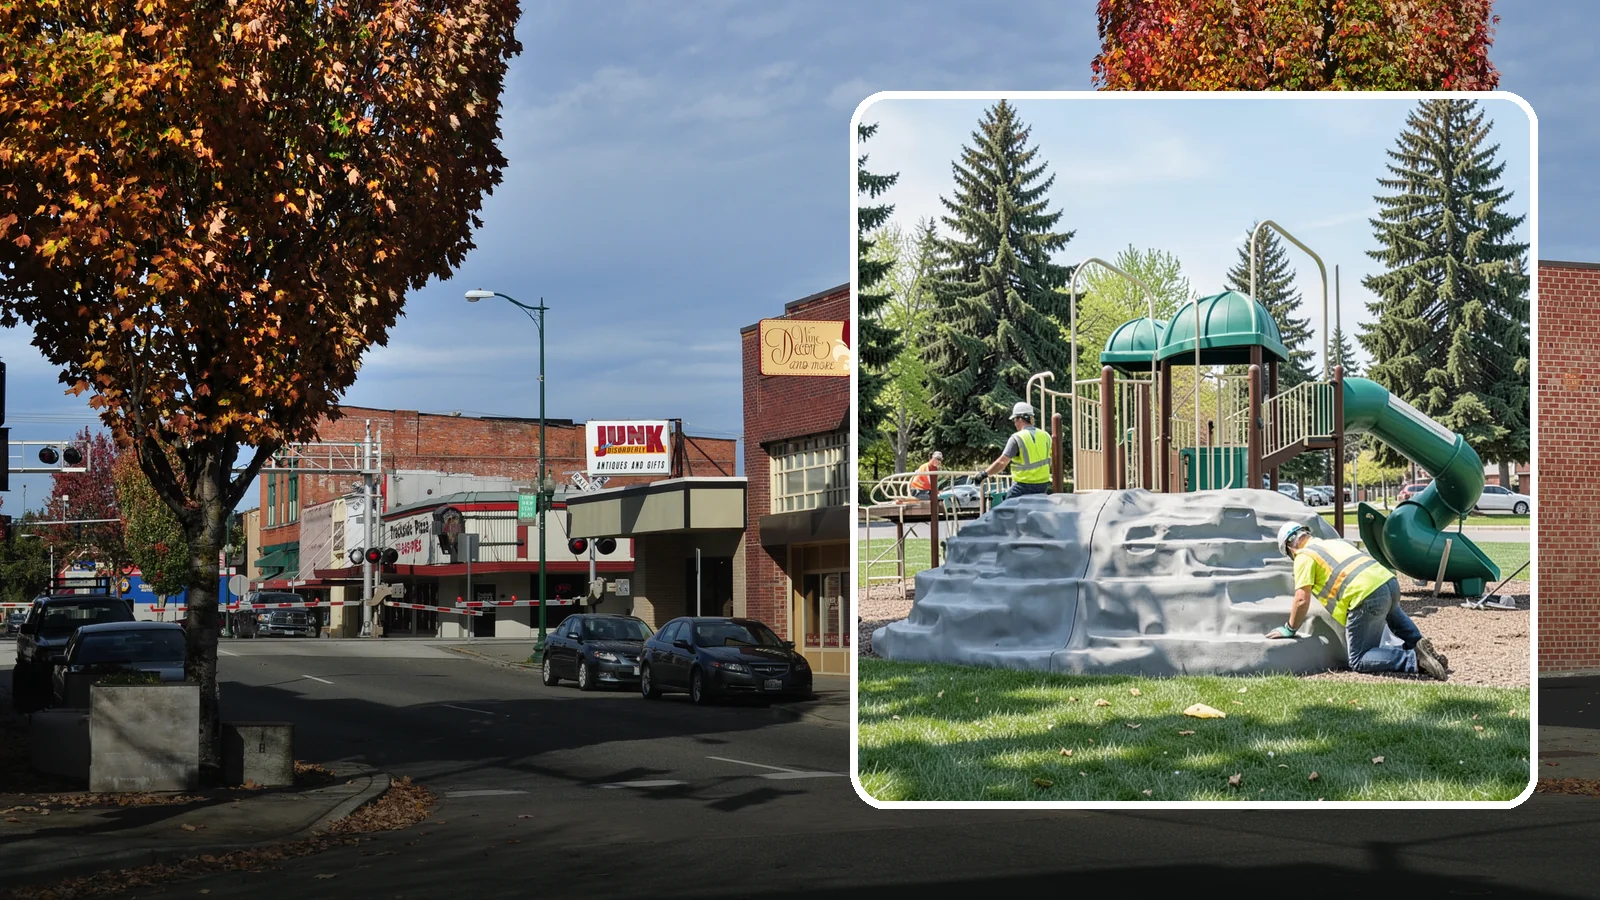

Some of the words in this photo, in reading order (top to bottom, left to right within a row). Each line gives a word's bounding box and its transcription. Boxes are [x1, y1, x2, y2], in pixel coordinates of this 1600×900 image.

[595, 425, 665, 457] JUNK
[607, 446, 646, 454] DISORDERLY
[597, 462, 628, 470] ANTIQUES
[631, 461, 644, 469] AND
[647, 460, 665, 469] GIFTS
